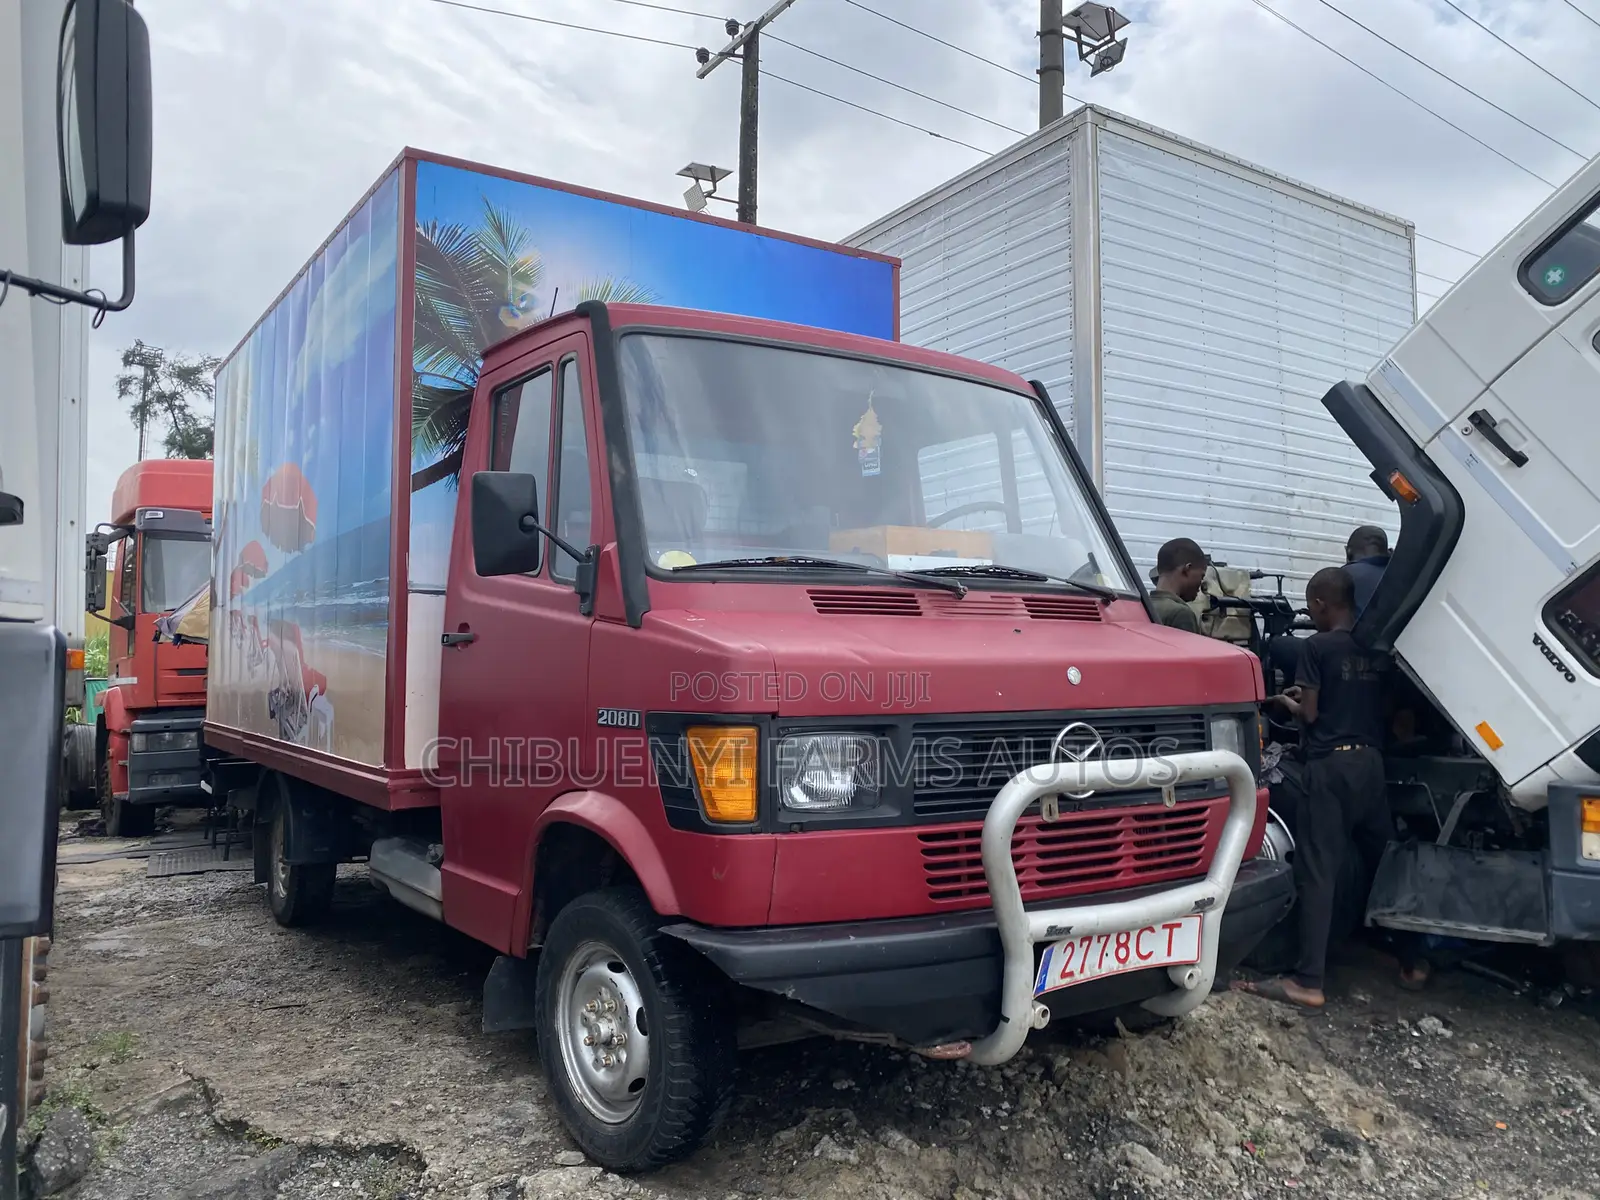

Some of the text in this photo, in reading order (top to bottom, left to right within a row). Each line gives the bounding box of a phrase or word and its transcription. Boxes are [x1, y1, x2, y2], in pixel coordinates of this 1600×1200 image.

[1532, 632, 1576, 683] VOLVO
[597, 709, 640, 727] 208D
[1059, 922, 1182, 980] 2778CT
